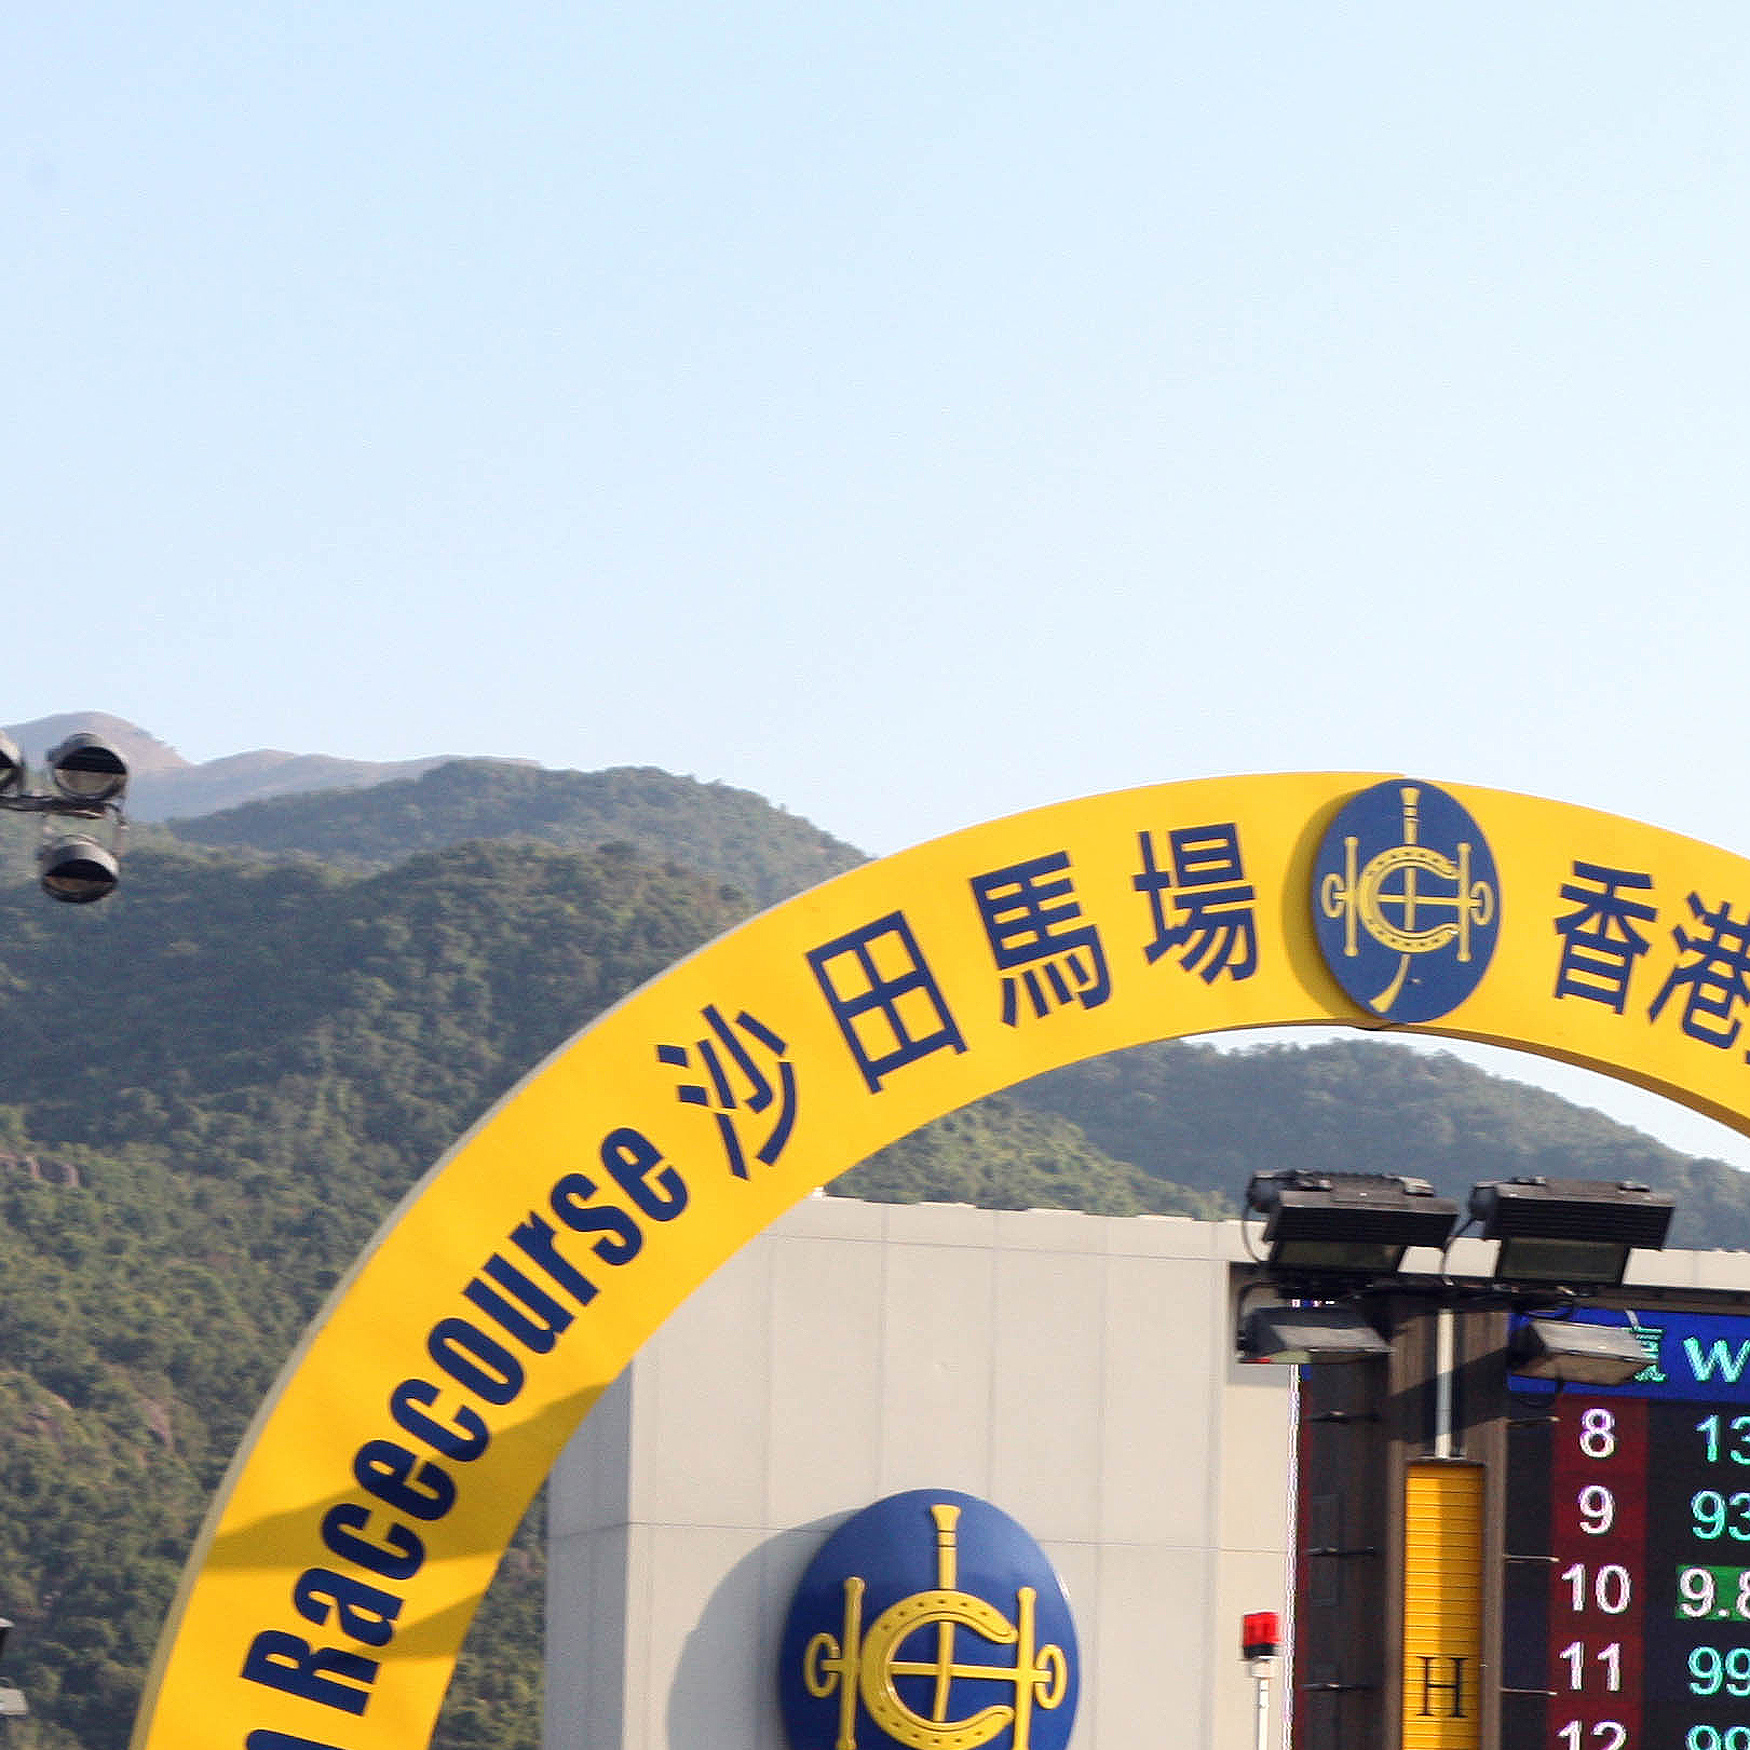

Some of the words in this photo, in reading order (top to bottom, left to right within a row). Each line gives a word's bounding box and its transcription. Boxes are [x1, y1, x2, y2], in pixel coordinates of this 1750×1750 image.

[656, 822, 1258, 1181] 沙田馬場
[242, 1127, 688, 1715] Racecourse
[1578, 1408, 1616, 1459] 8
[1578, 1485, 1617, 1536] 9
[1560, 1563, 1633, 1615] 10
[1560, 1642, 1621, 1692] 11
